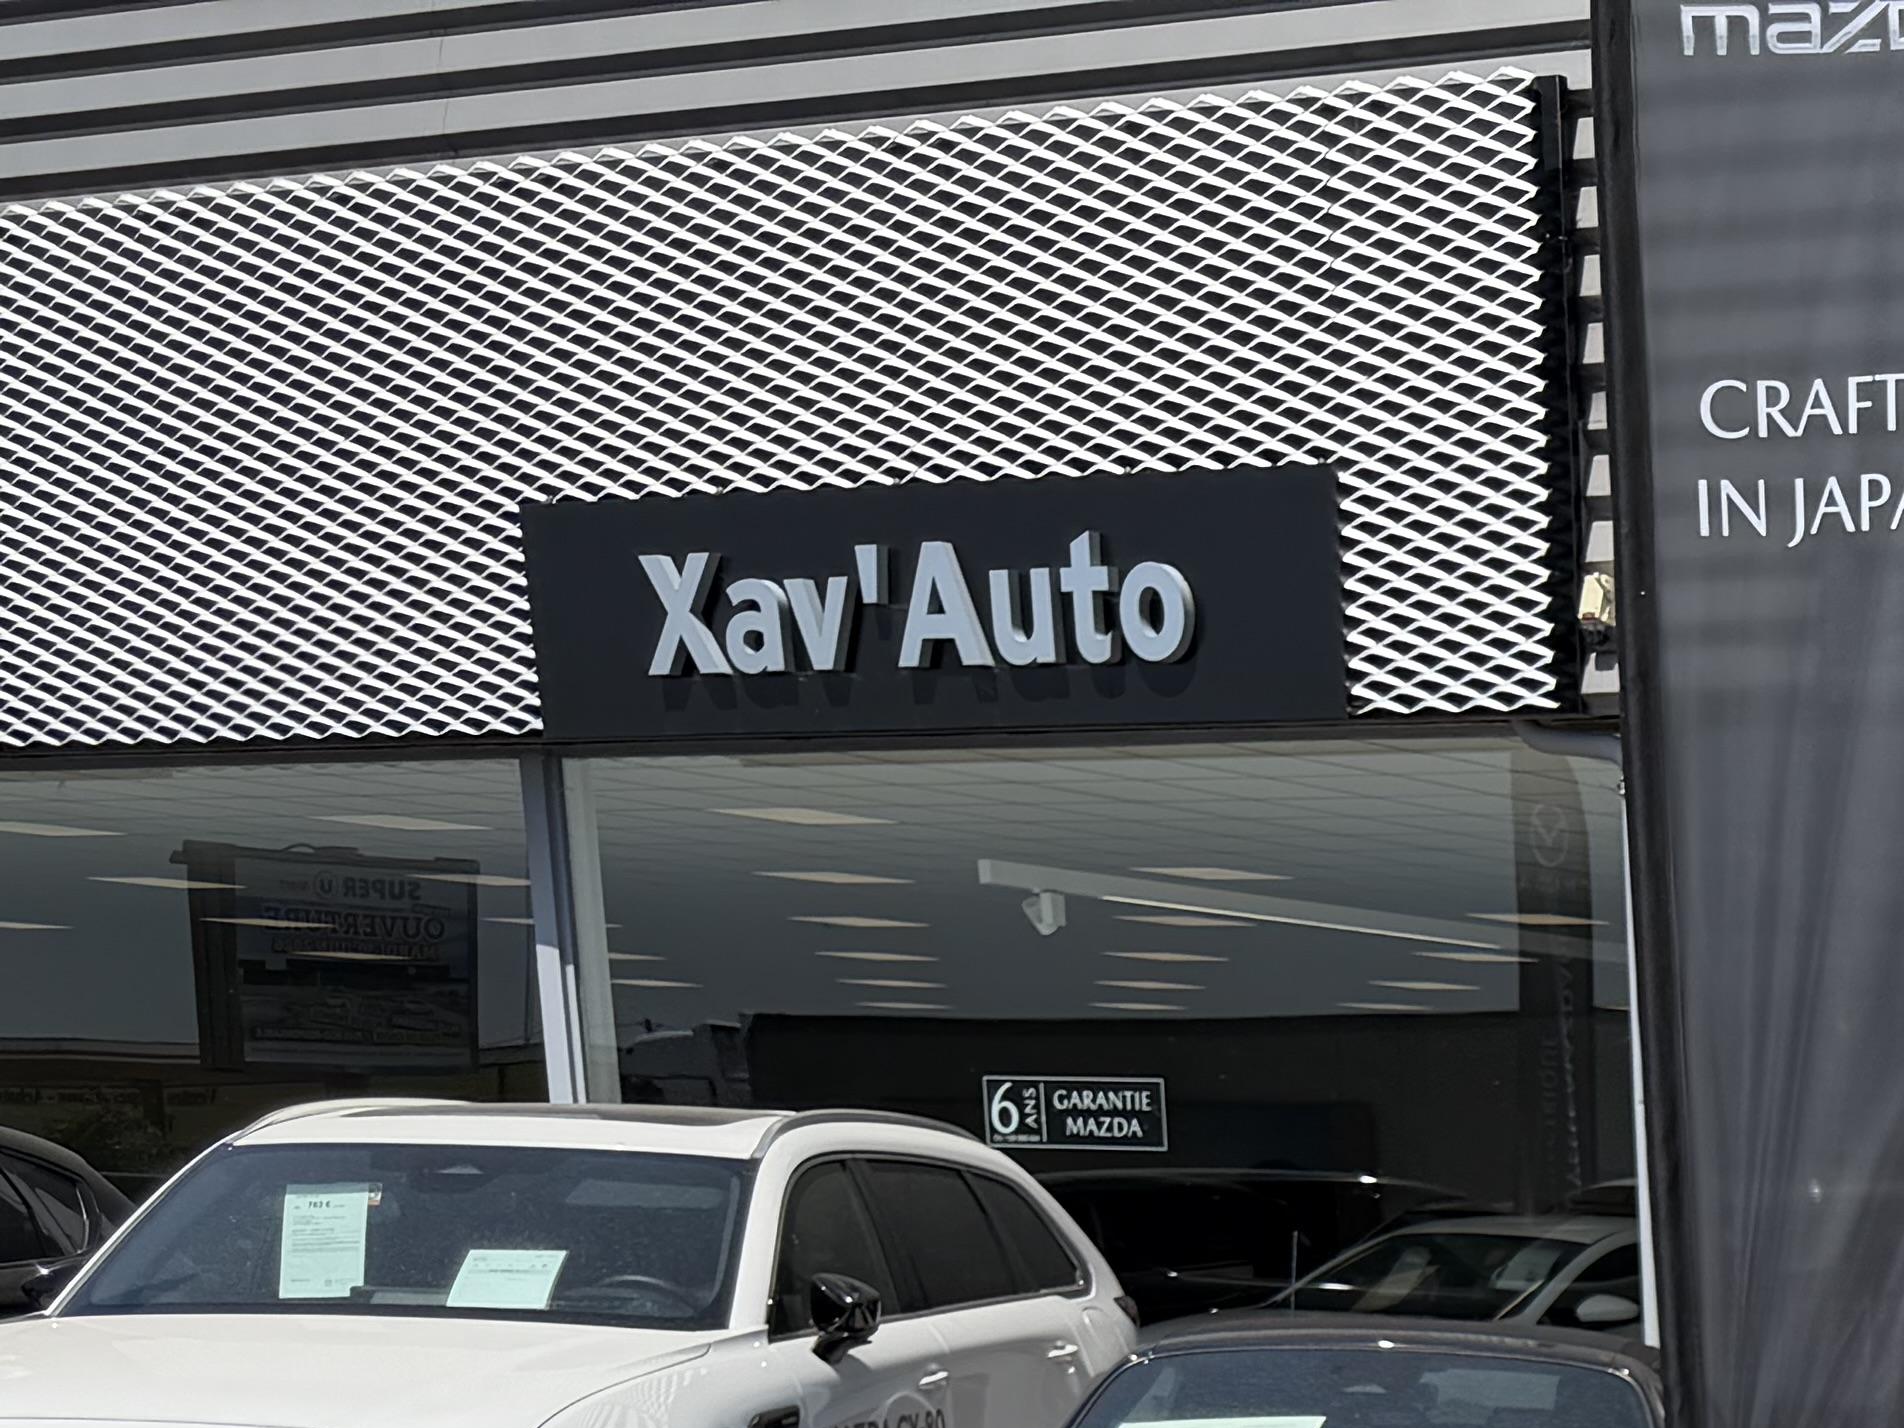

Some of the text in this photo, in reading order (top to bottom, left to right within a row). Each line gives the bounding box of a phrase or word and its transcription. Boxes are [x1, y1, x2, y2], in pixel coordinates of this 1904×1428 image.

[1697, 478, 1767, 537] IN
[638, 530, 1195, 676] Xav'Auto
[991, 1081, 1038, 1134] 6 ANS
[1053, 1089, 1152, 1112] GARANTIE
[1066, 1116, 1143, 1138] MAZDA
